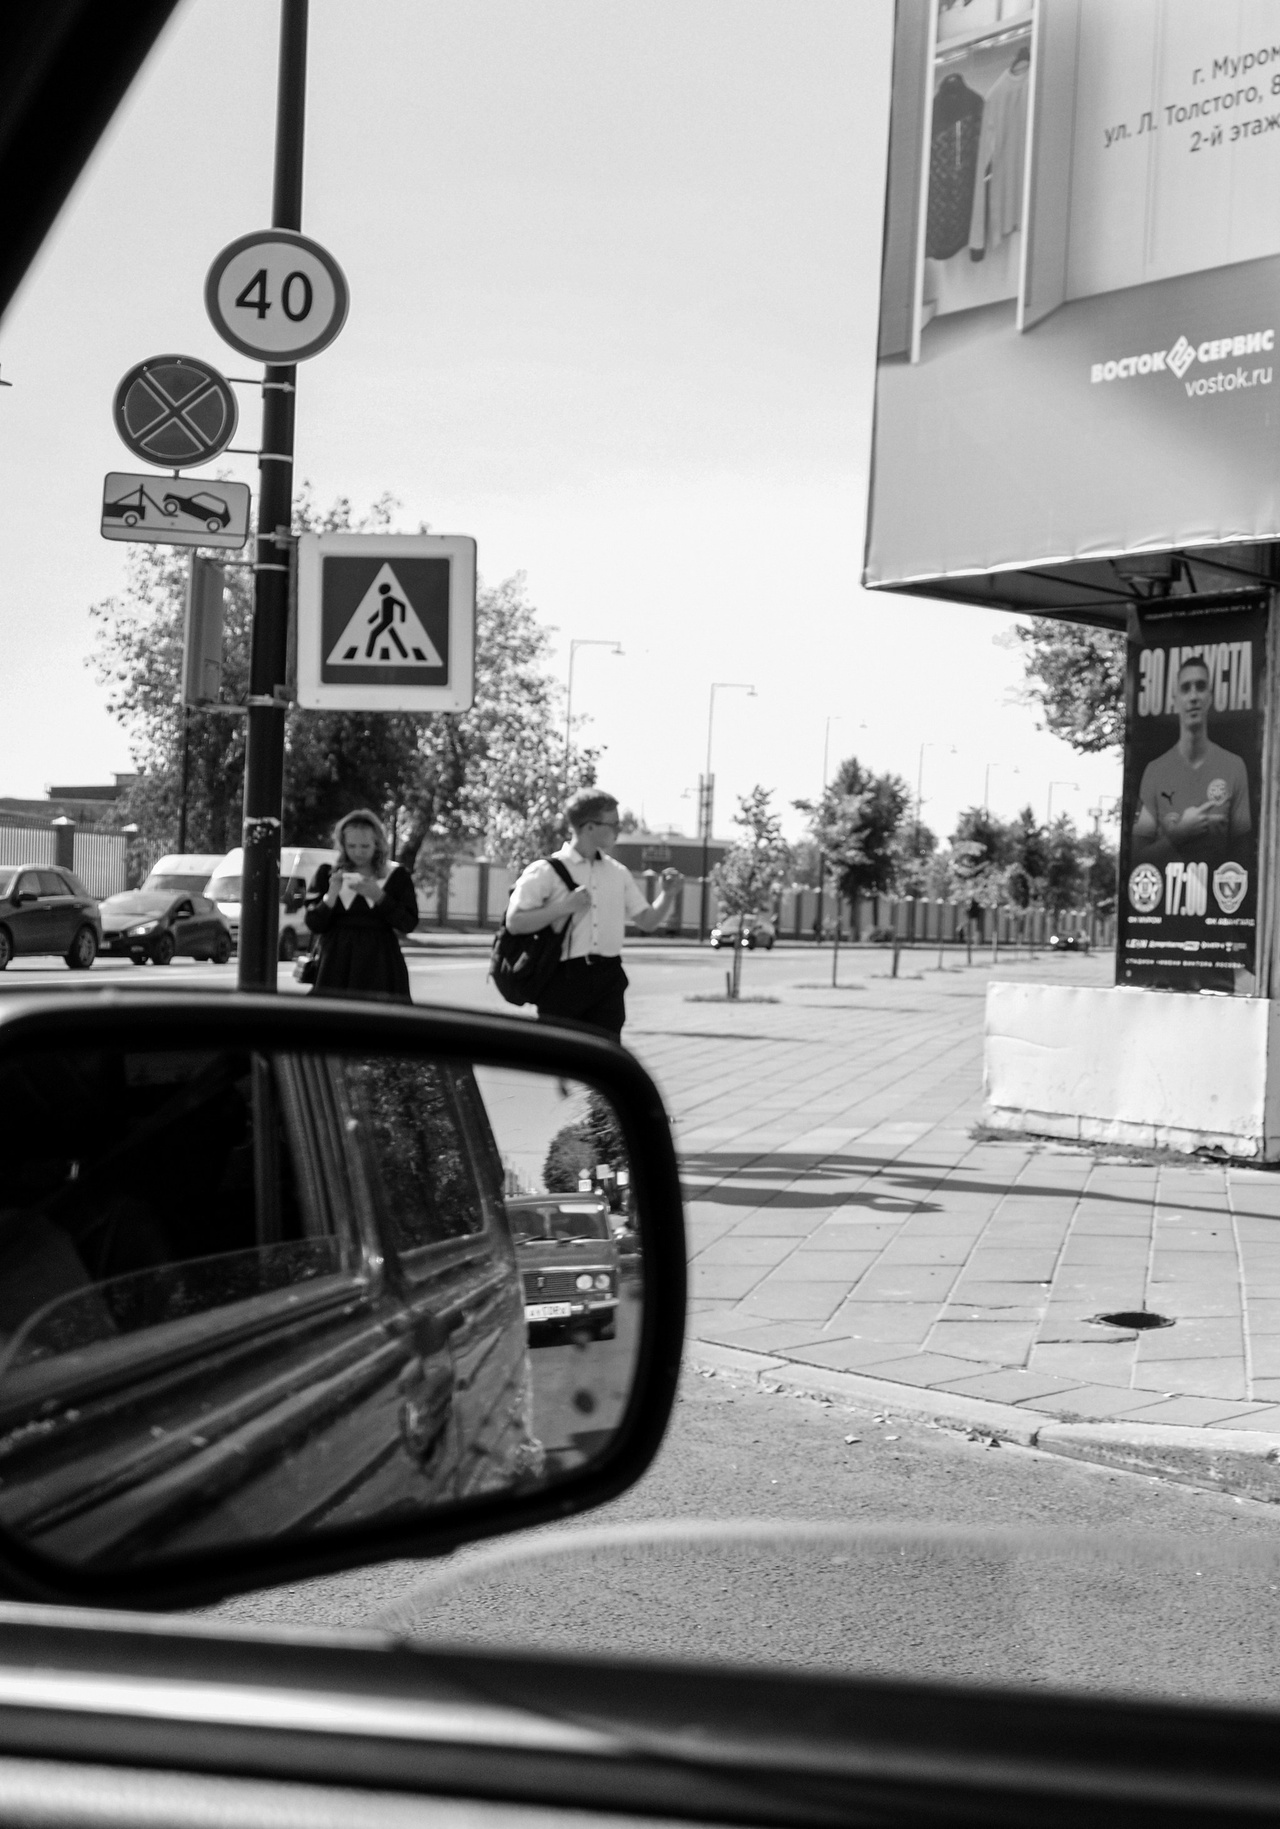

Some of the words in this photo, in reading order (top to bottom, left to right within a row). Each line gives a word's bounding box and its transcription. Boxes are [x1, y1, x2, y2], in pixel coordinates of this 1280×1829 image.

[1192, 66, 1205, 85] г.
[1104, 124, 1131, 148] ул.
[1137, 112, 1158, 136] Л.
[1165, 85, 1264, 126] Толстого,
[1189, 126, 1223, 153] 2-й
[235, 268, 313, 322] 40
[1091, 350, 1167, 383] ВОСТОК
[1197, 330, 1275, 363] СЕРВИС
[1185, 364, 1273, 397] vostok.ru
[1138, 647, 1166, 717] 30
[1165, 640, 1253, 715] АУСТА
